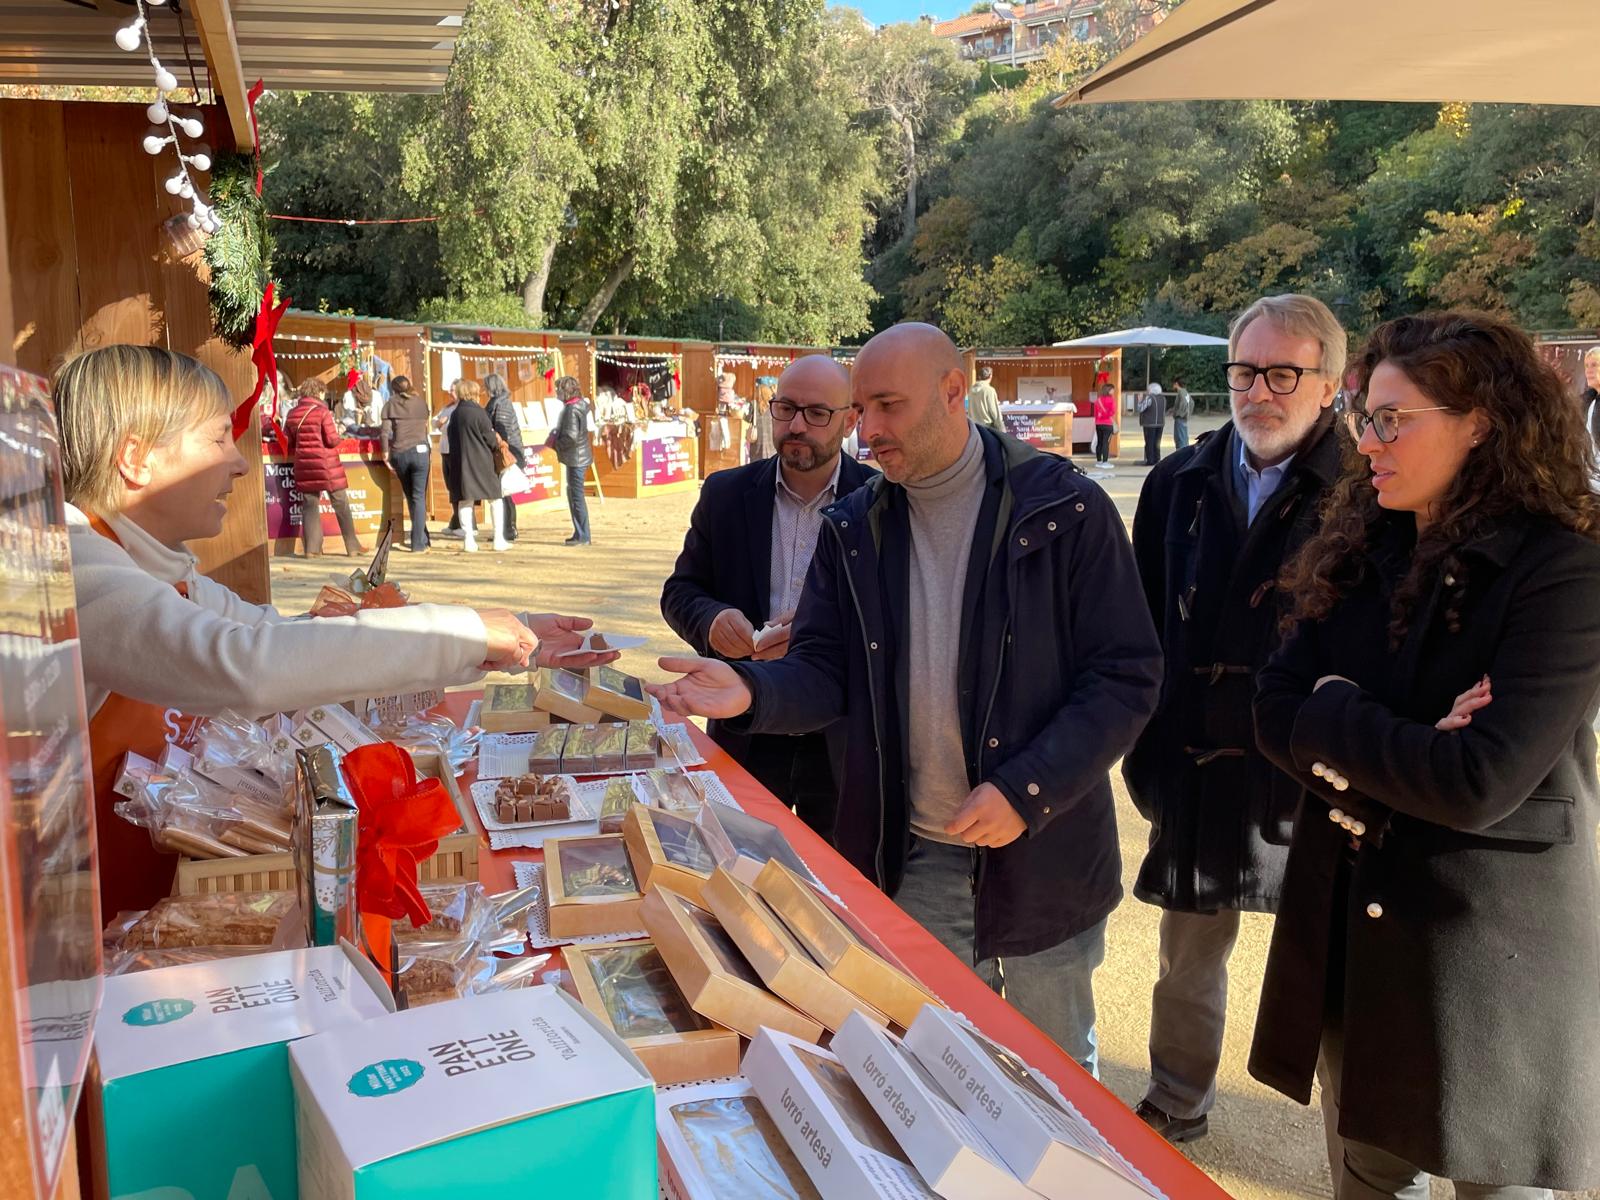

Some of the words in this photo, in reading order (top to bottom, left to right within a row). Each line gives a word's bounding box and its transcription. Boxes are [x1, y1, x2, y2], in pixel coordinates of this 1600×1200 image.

[205, 987, 242, 1014] PAN
[234, 984, 272, 1009] ETT
[263, 978, 300, 1003] ONE
[428, 1042, 477, 1078] PAN
[459, 1036, 508, 1069] ETT
[488, 1029, 536, 1062] ONE
[862, 1054, 889, 1089] torró
[883, 1085, 918, 1129] artesà
[942, 1045, 969, 1081] torró
[965, 1077, 1004, 1121] artesà
[780, 1087, 806, 1125] torró
[800, 1121, 833, 1169] artesà
